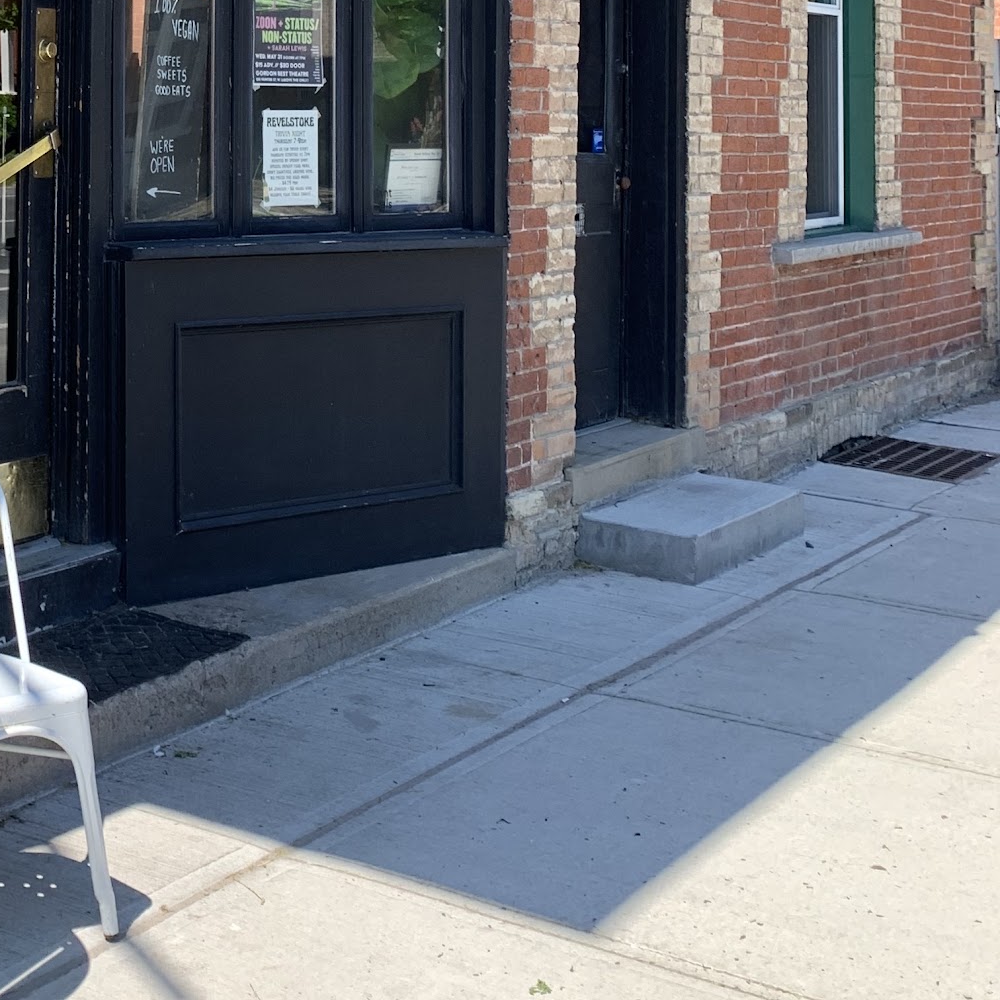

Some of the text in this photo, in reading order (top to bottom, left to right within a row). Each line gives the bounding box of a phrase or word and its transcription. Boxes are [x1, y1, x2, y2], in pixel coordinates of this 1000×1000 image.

[255, 16, 277, 29] ZOON
[284, 17, 319, 30] STATUS/
[172, 19, 200, 42] VEGAN
[261, 30, 312, 44] NON-STATUS
[157, 55, 181, 67] COFFEE
[157, 69, 187, 83] SWEETS
[155, 85, 191, 98] GOOD EATS
[266, 116, 315, 128] REVELSTOKE
[149, 135, 175, 154] WE'RE
[150, 155, 175, 174] OPEN
